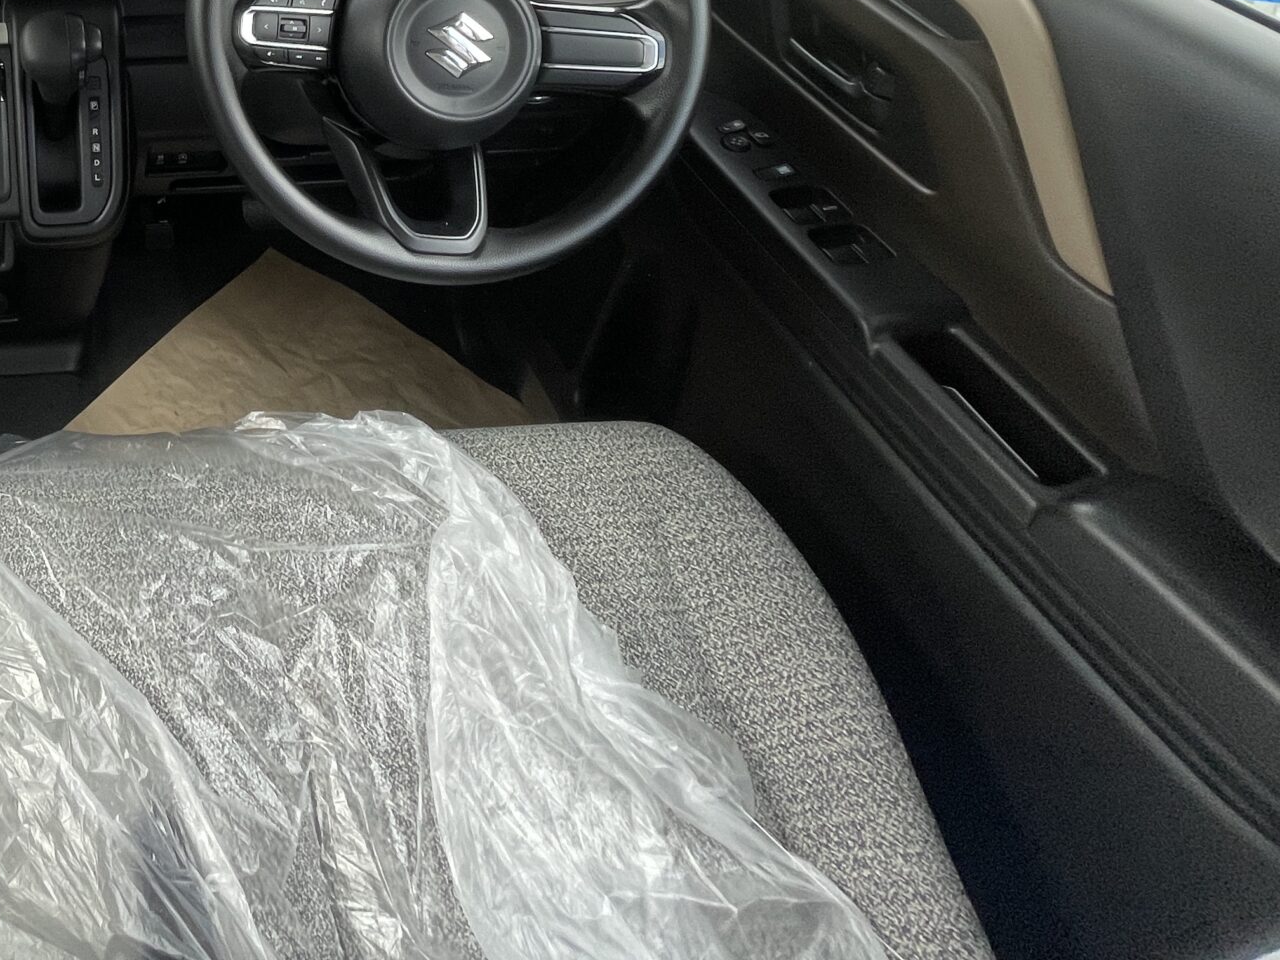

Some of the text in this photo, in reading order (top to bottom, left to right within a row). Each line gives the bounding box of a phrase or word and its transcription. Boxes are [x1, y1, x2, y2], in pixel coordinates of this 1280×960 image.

[92, 128, 99, 136] R
[92, 143, 101, 153] N
[93, 159, 101, 167] D
[94, 174, 101, 182] L
